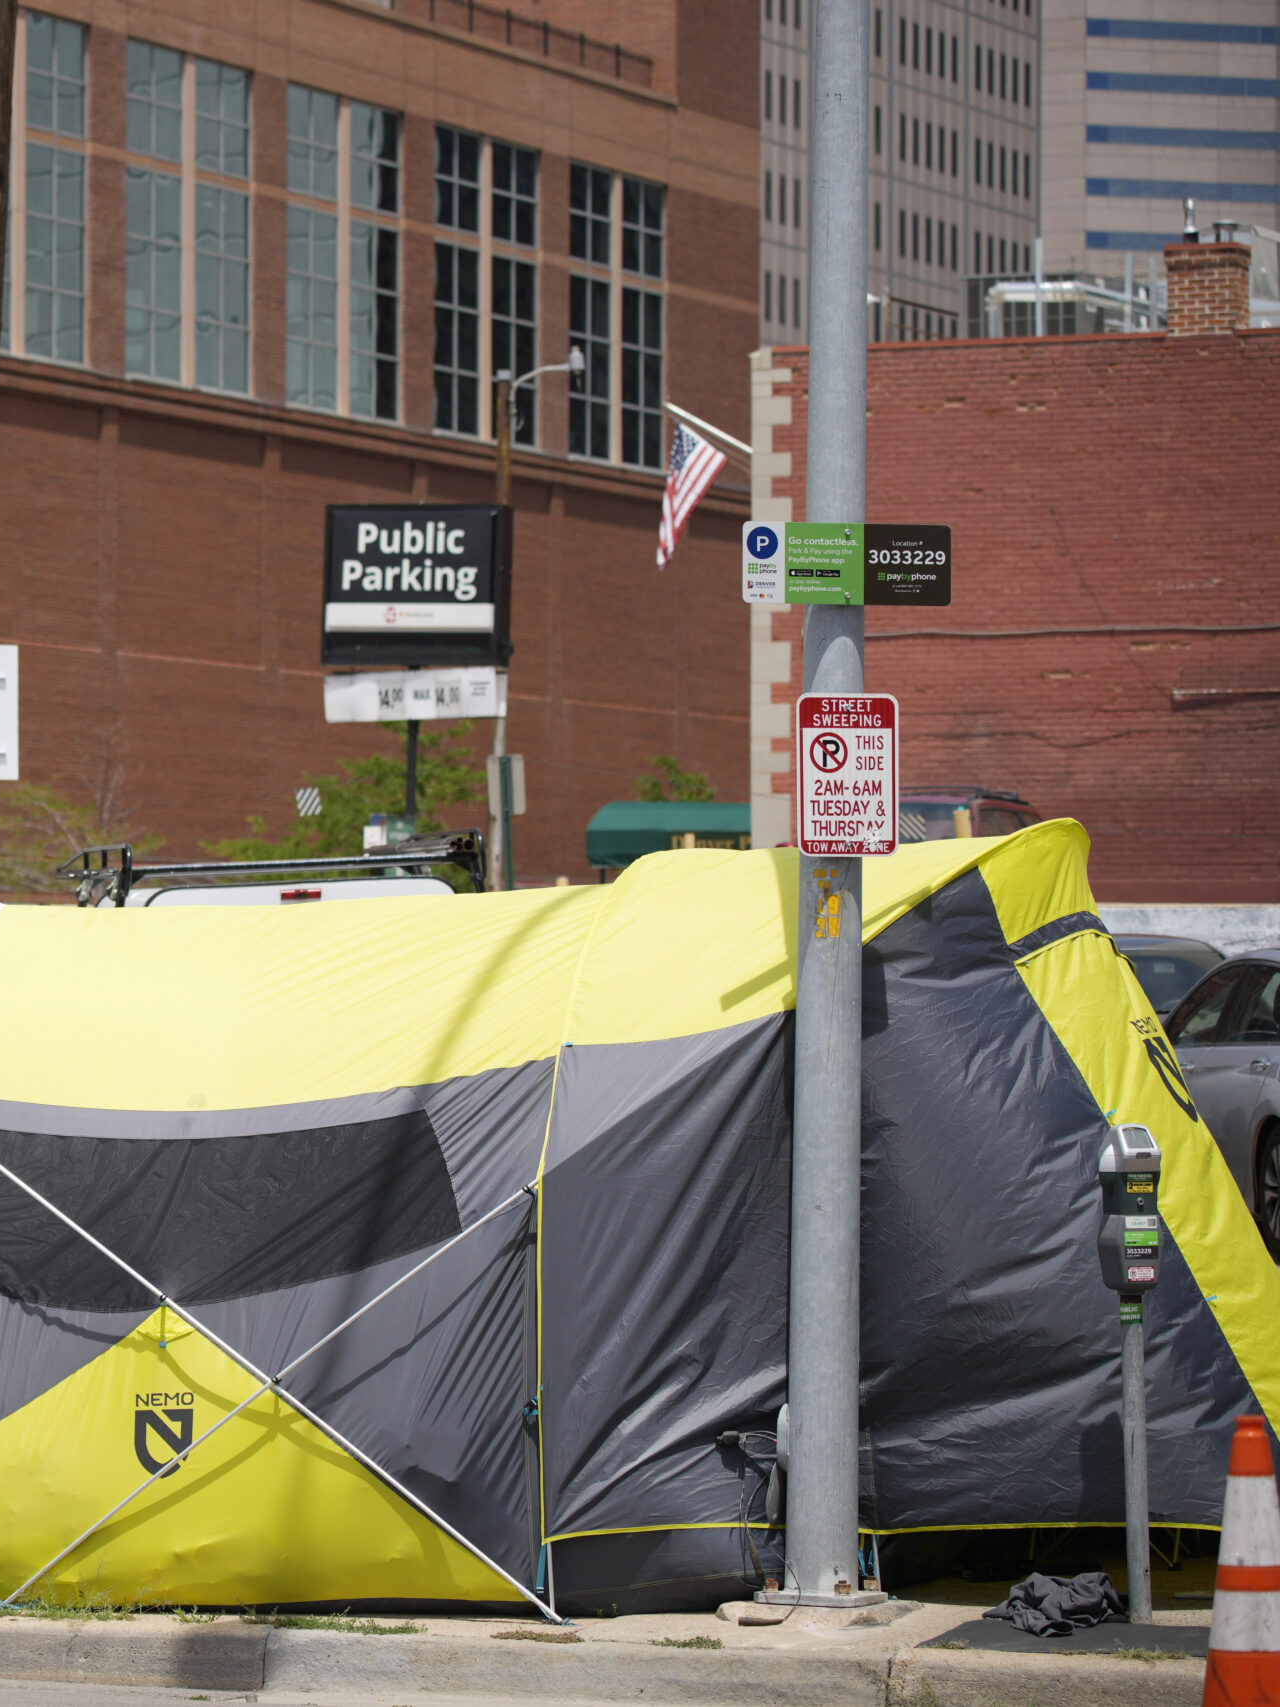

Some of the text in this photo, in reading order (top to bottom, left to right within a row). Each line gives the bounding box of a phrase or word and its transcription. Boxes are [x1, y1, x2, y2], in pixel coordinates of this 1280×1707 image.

[357, 520, 465, 554] Public
[789, 536, 859, 546] Go contactless.
[788, 556, 847, 566] PayByPhone app.
[868, 549, 946, 565] 3033229
[341, 558, 478, 601] Parking
[886, 572, 937, 582] paybyphone
[788, 585, 841, 593] paybyphone.com
[821, 699, 873, 713] STREET
[812, 713, 882, 728] SWEEPING
[855, 735, 884, 751] THIS
[855, 755, 884, 771] SIDE
[810, 800, 886, 817] TUESDAY &
[807, 842, 830, 853] TOW
[830, 842, 860, 853] AWAY
[1128, 1182, 1134, 1190] 2
[1126, 1247, 1152, 1255] 3033229
[135, 1392, 194, 1407] NEMO
